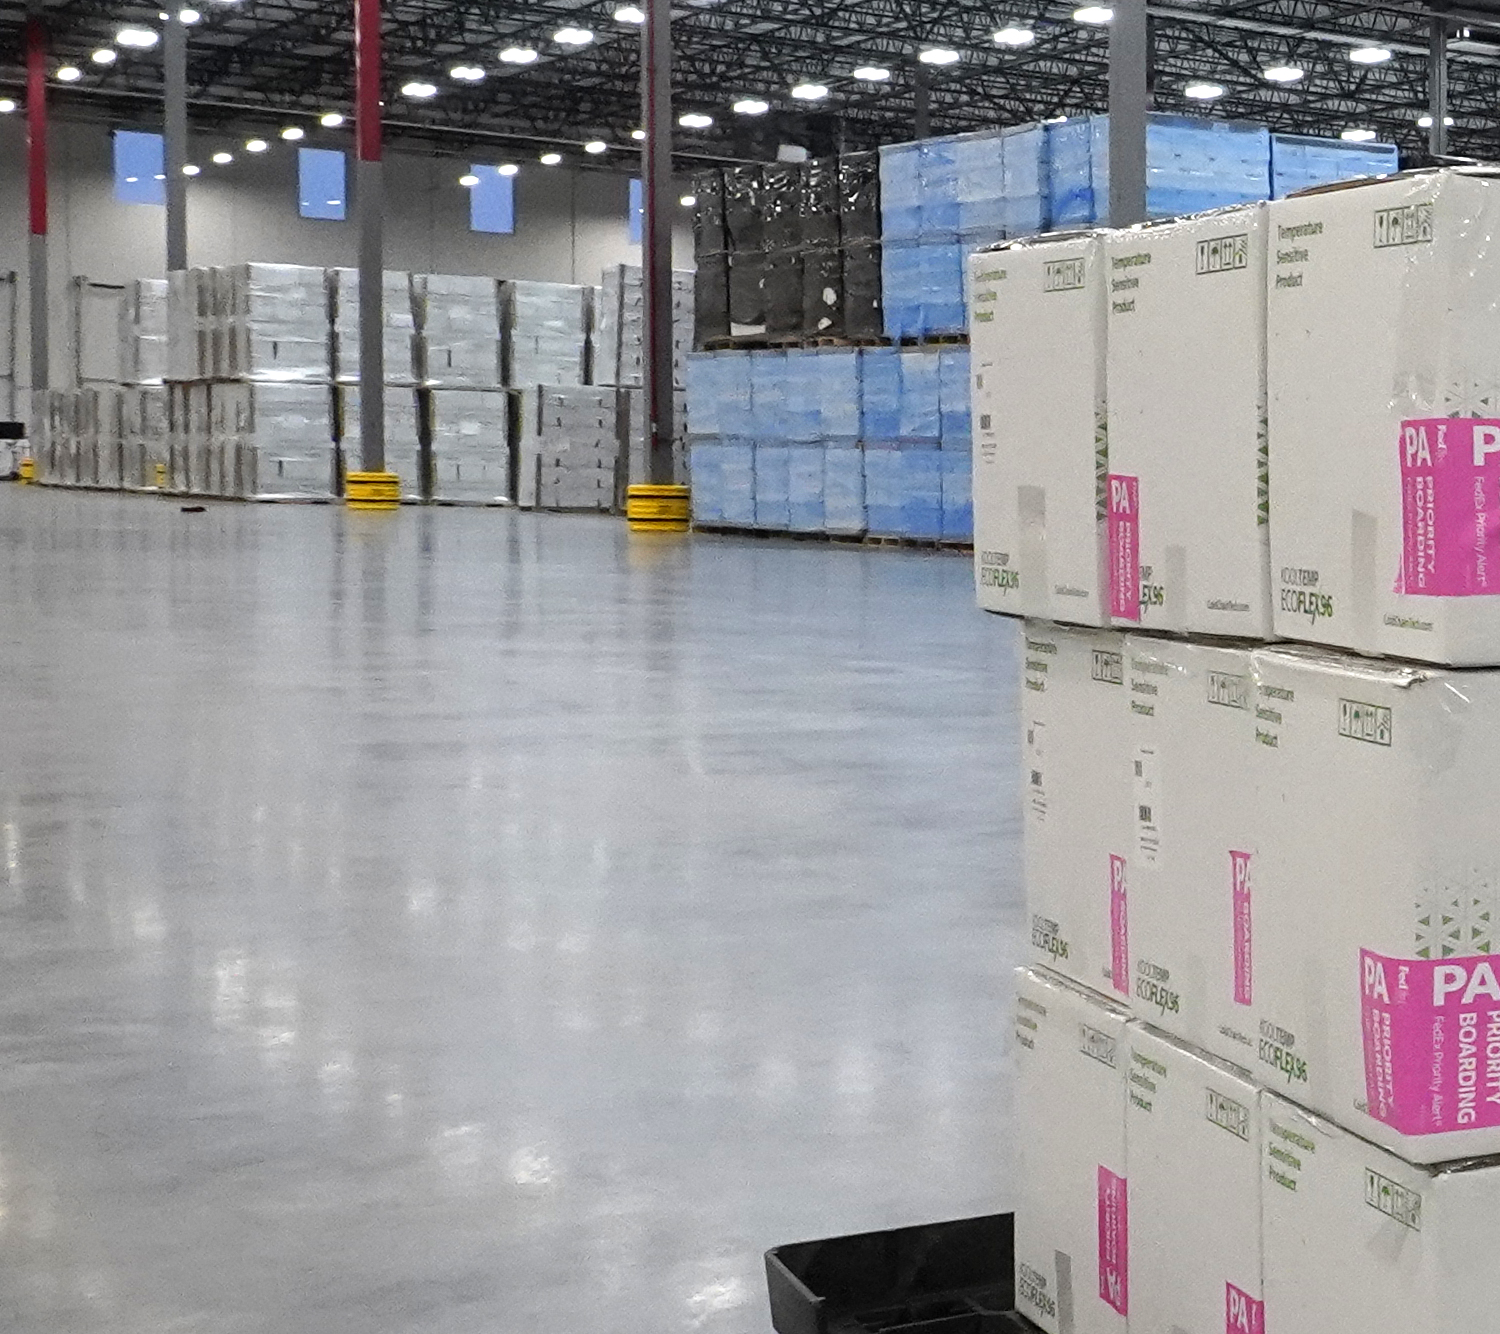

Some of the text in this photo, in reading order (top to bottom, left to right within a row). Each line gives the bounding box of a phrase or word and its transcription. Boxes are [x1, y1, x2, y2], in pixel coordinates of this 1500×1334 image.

[1277, 221, 1323, 242] Temperature
[1276, 247, 1309, 265] Sensitive
[1276, 272, 1303, 289] Product
[1403, 426, 1433, 467] PA
[1110, 480, 1131, 515] PA
[1472, 476, 1485, 514] FedEx
[1426, 475, 1437, 574] PRIORITY
[1475, 514, 1487, 553] Priority
[1281, 567, 1319, 587] KOOLTEMP
[1281, 587, 1333, 625] ECOFLEX96
[1364, 956, 1390, 1005] PA
[1432, 1016, 1444, 1050] FedEx
[1381, 1012, 1395, 1109] PRIORITY
[1429, 1051, 1444, 1093] Priority
[1456, 1012, 1478, 1125] BOARDING
[1228, 1287, 1250, 1334] PA
